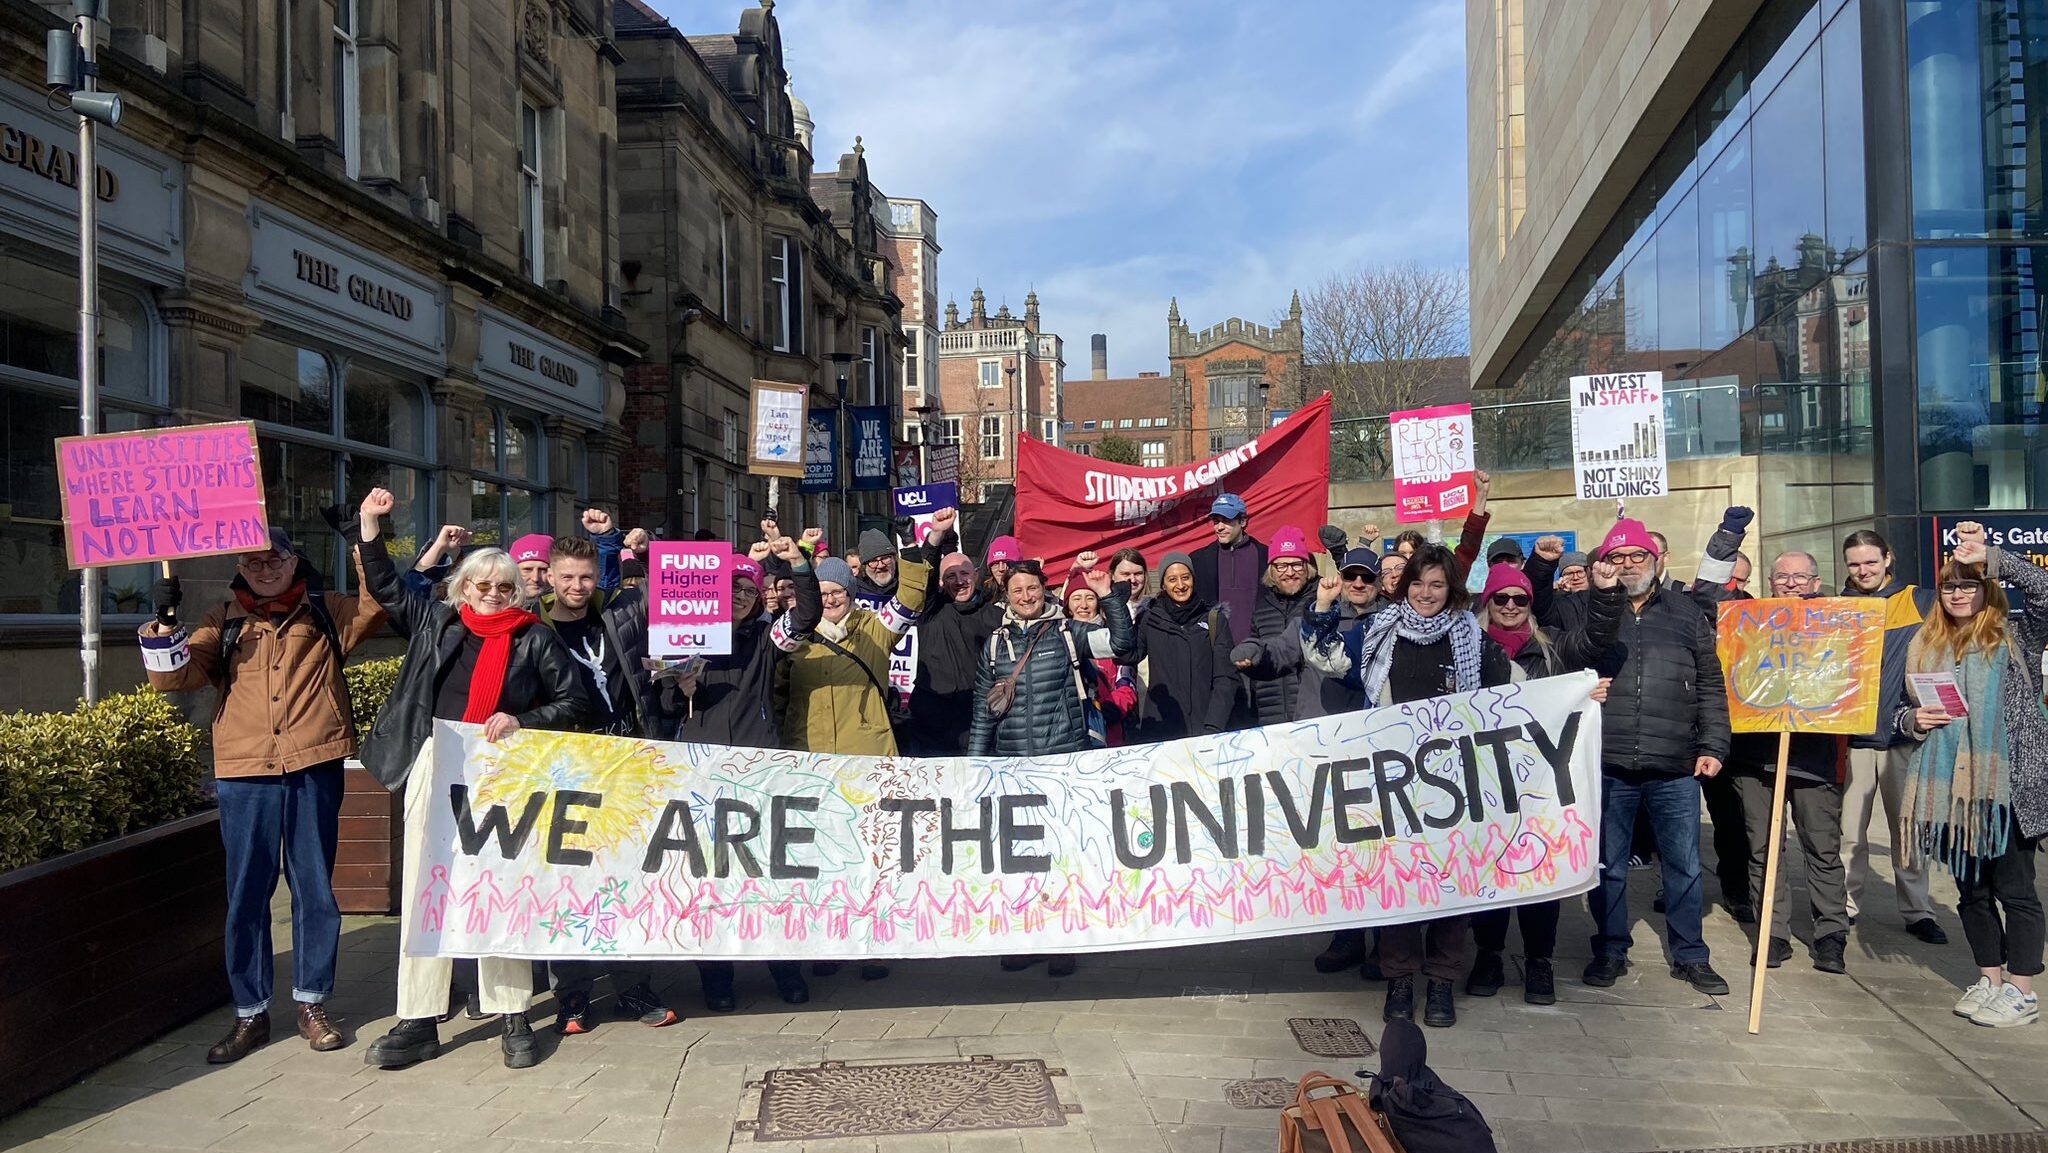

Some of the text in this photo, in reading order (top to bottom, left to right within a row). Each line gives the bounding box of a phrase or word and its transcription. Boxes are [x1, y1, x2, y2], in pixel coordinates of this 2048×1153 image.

[293, 248, 414, 321] THE GRAND
[508, 341, 579, 387] THE GRAND
[1589, 374, 1646, 392] INVEST
[1580, 388, 1649, 407] IN STAFF
[771, 409, 789, 419] I am
[768, 422, 789, 432] very
[861, 419, 881, 439] WE
[1398, 418, 1448, 443] RISE
[766, 433, 792, 442] upset
[70, 432, 253, 473] UNIVERSITIES
[859, 439, 883, 458] ARE
[1400, 439, 1446, 460] LIKE
[1401, 451, 1467, 475] LIONS
[67, 457, 256, 496] WHERE STUDENTS
[1583, 466, 1663, 484] NOT SHINY
[1085, 470, 1178, 503] STUDENTS
[1582, 480, 1661, 499] BUILDINGS
[88, 488, 200, 527] LEARN
[82, 525, 160, 562] NOT
[660, 554, 721, 570] FUND
[661, 571, 719, 588] Higher
[661, 588, 719, 599] Education
[660, 599, 720, 616] NOW!
[1736, 607, 1876, 636] NO MORE
[1769, 631, 1825, 649] HOT
[449, 710, 1584, 880] WE ARE THE UNIVERSITY
